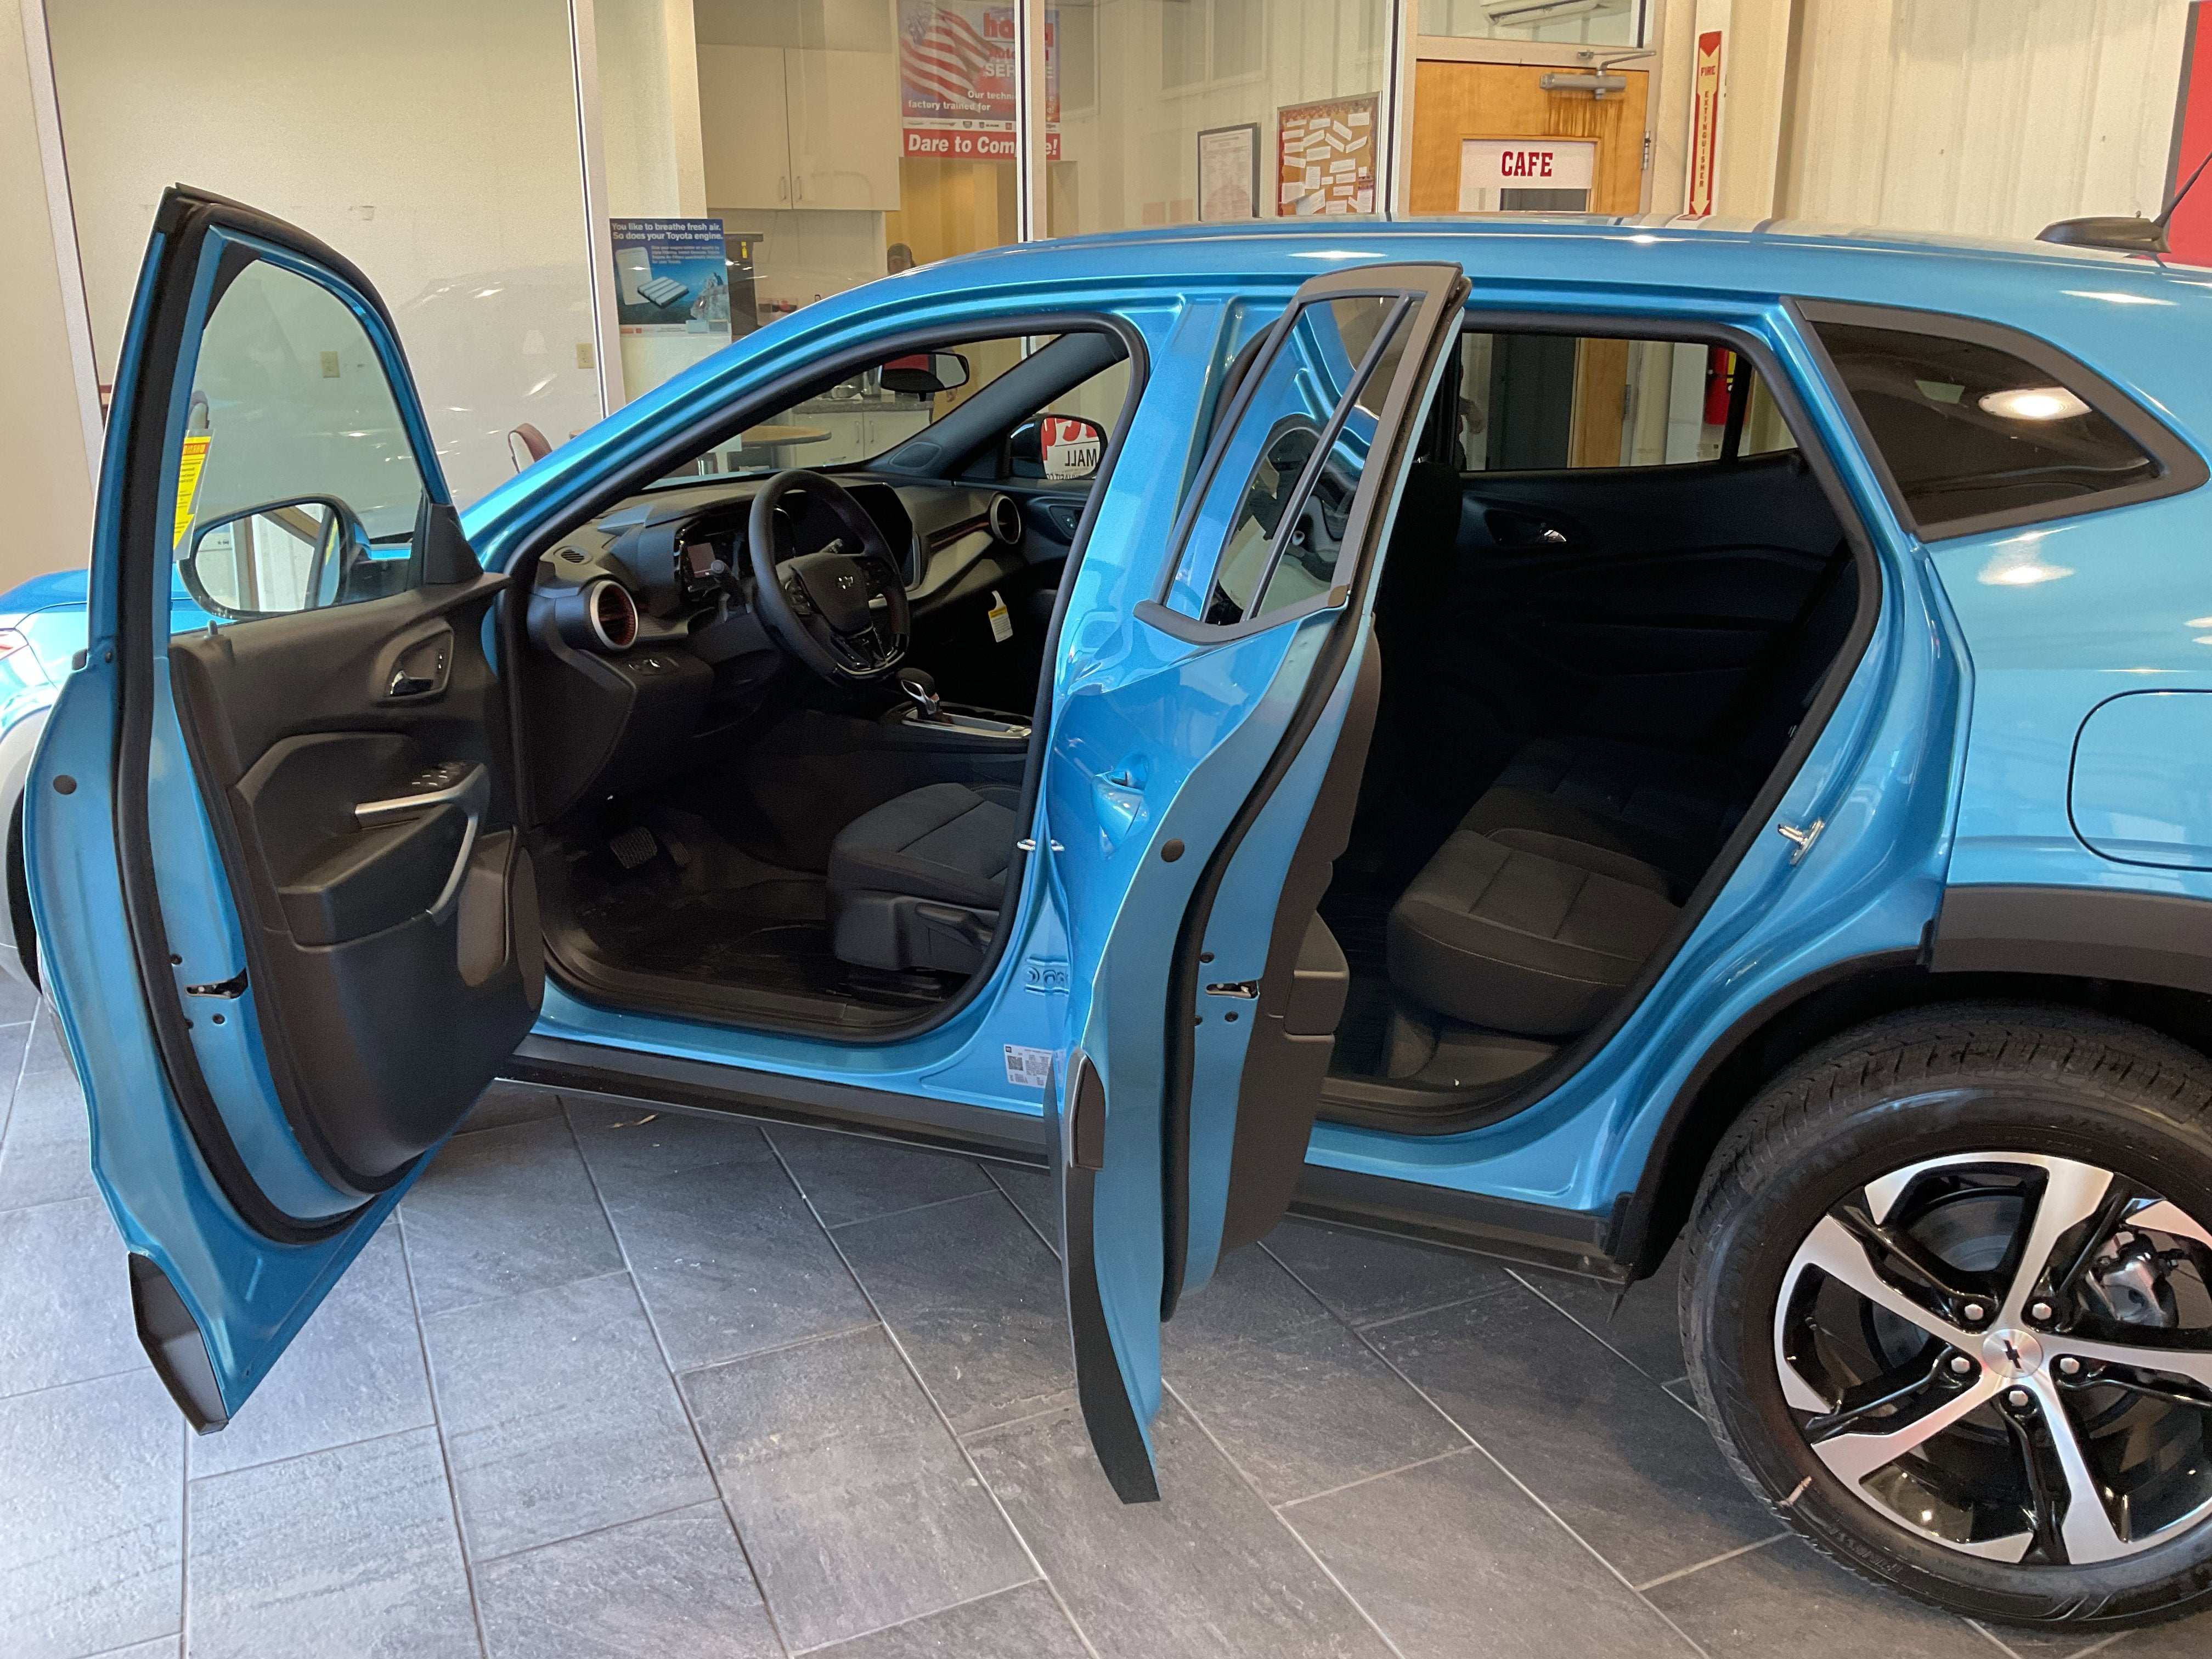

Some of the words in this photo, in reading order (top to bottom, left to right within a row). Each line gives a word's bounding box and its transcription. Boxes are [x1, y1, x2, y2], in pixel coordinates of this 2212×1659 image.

[1701, 66, 1716, 76] FIRE
[968, 90, 984, 99] Our
[987, 91, 1015, 100] techni
[909, 99, 941, 111] factory
[943, 101, 976, 110] trained
[978, 102, 991, 111] for
[909, 134, 949, 152] Dare
[955, 136, 972, 153] to
[1699, 91, 1709, 187] EXTINGUISHER
[1502, 151, 1553, 177] CAFE
[647, 233, 665, 241] your
[666, 232, 693, 241] Toyota
[694, 232, 724, 241] engine.
